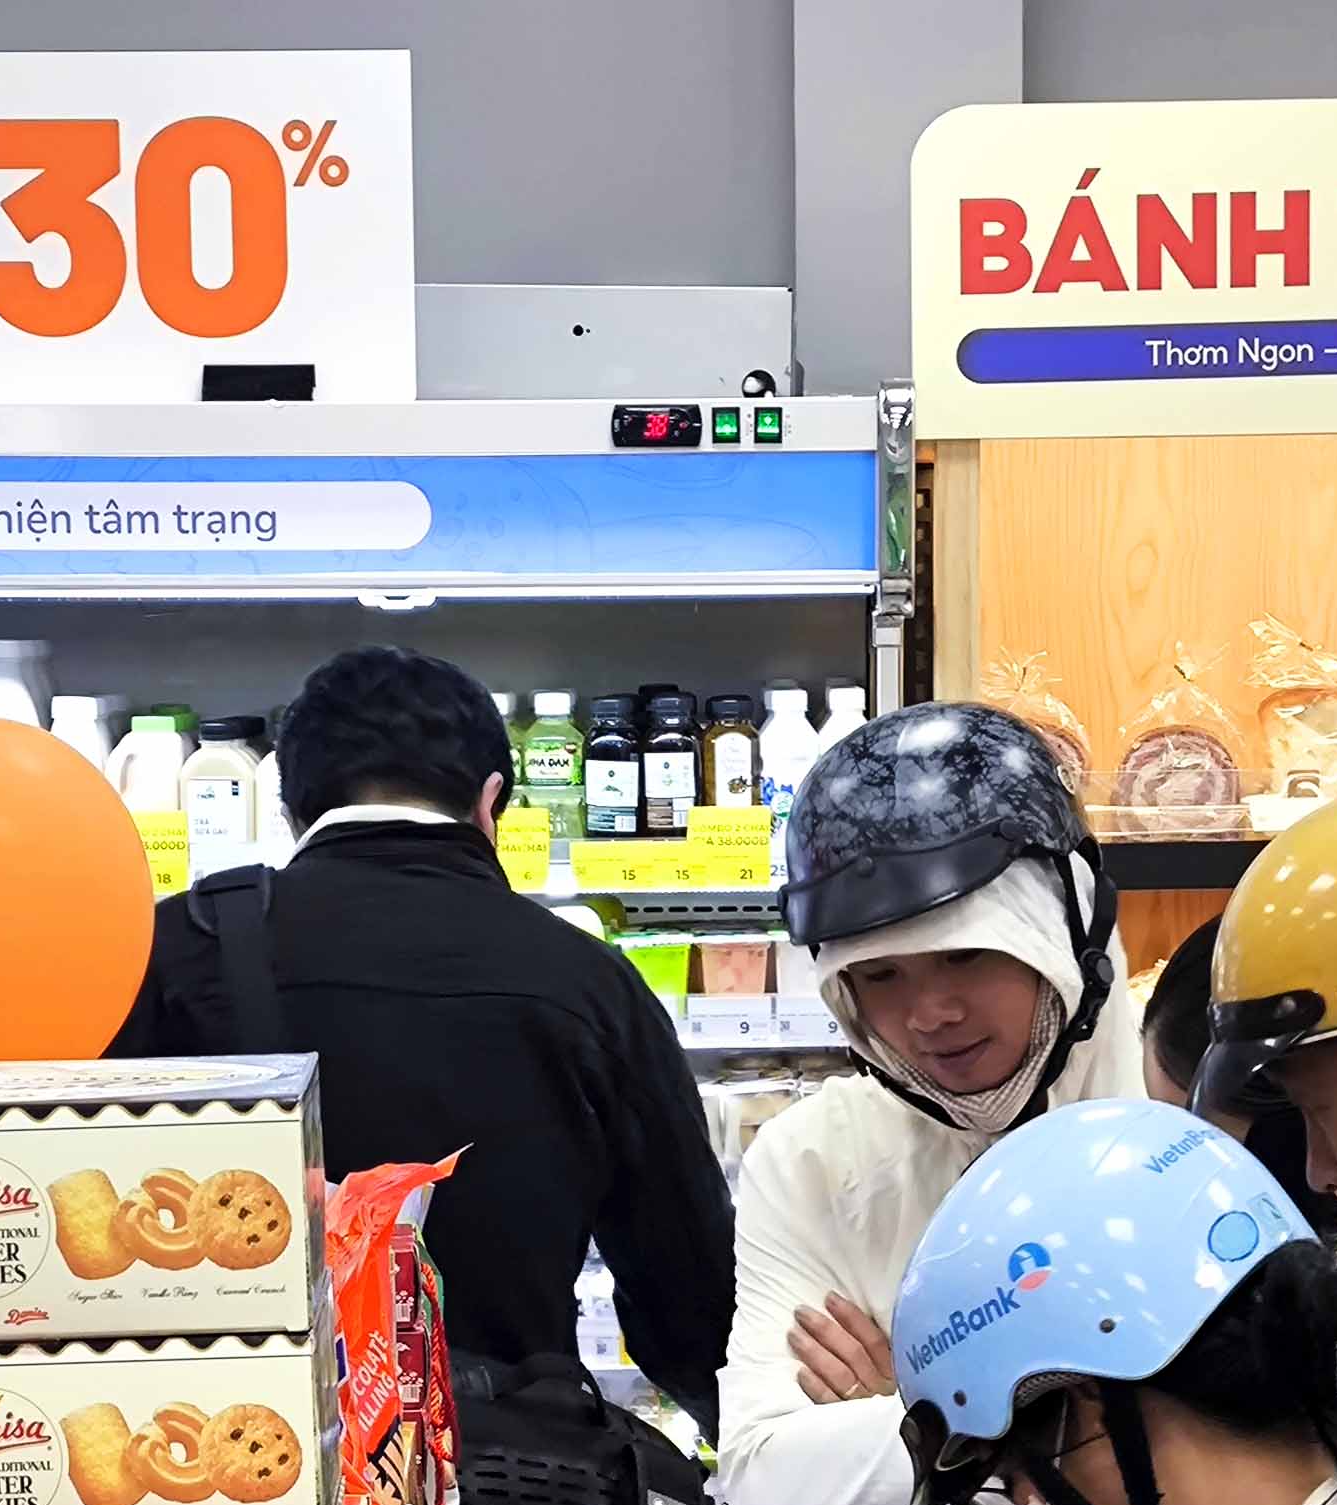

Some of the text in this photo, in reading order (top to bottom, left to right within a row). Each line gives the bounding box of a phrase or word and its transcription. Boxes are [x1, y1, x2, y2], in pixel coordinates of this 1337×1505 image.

[959, 167, 1312, 295] BÁNH
[1145, 337, 1228, 369] Thơm
[1236, 336, 1315, 373] Ngon
[83, 496, 161, 537] tâm
[172, 501, 279, 550] trạng
[156, 873, 172, 884] 18
[622, 870, 636, 881] 15
[675, 869, 690, 880] 15
[740, 869, 753, 880] 21
[740, 1021, 750, 1034] 9
[905, 1286, 1021, 1376] VietinBank
